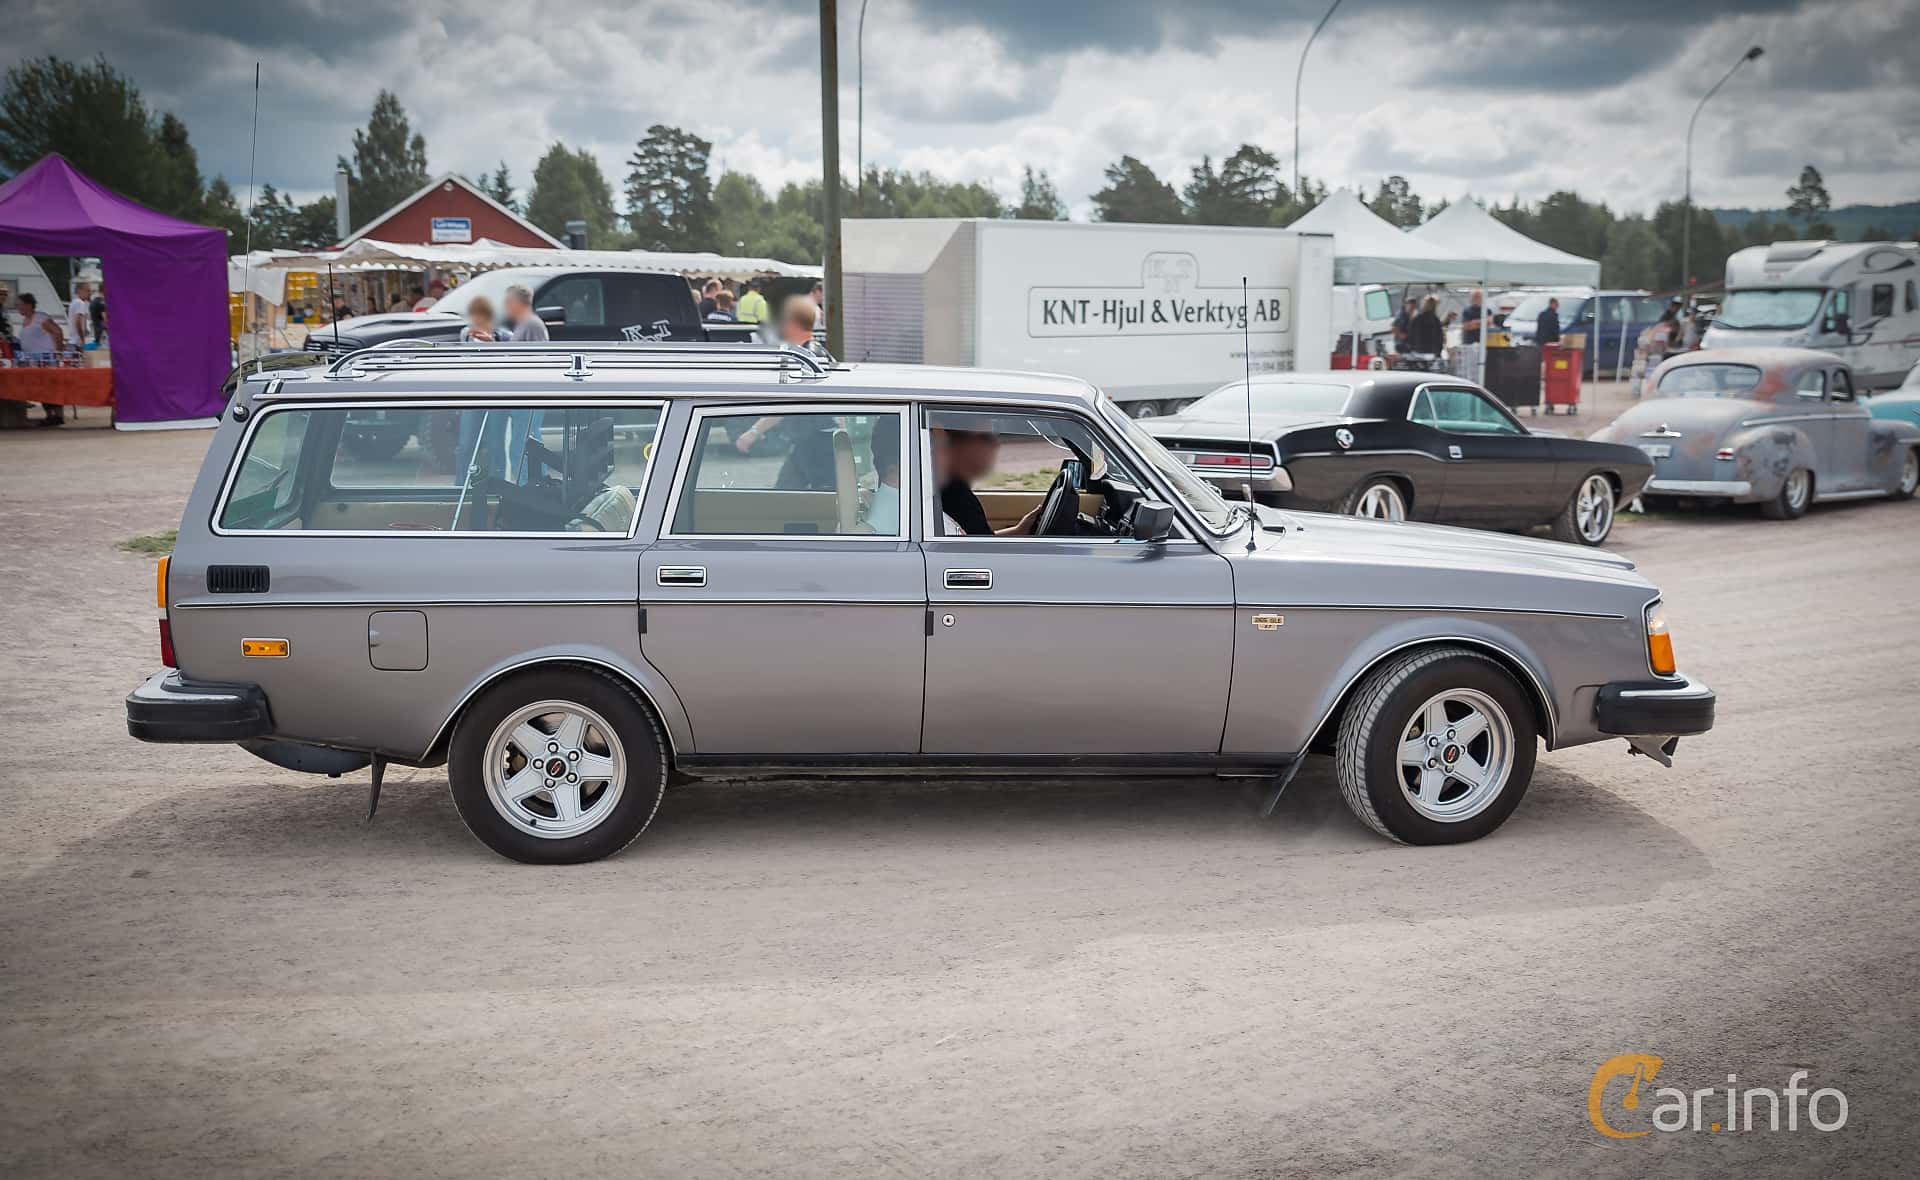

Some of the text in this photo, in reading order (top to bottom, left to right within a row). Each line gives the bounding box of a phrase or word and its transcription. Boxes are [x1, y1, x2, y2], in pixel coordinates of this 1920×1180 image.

[1042, 299, 1281, 330] KNT-Hjul & Verktyg AB
